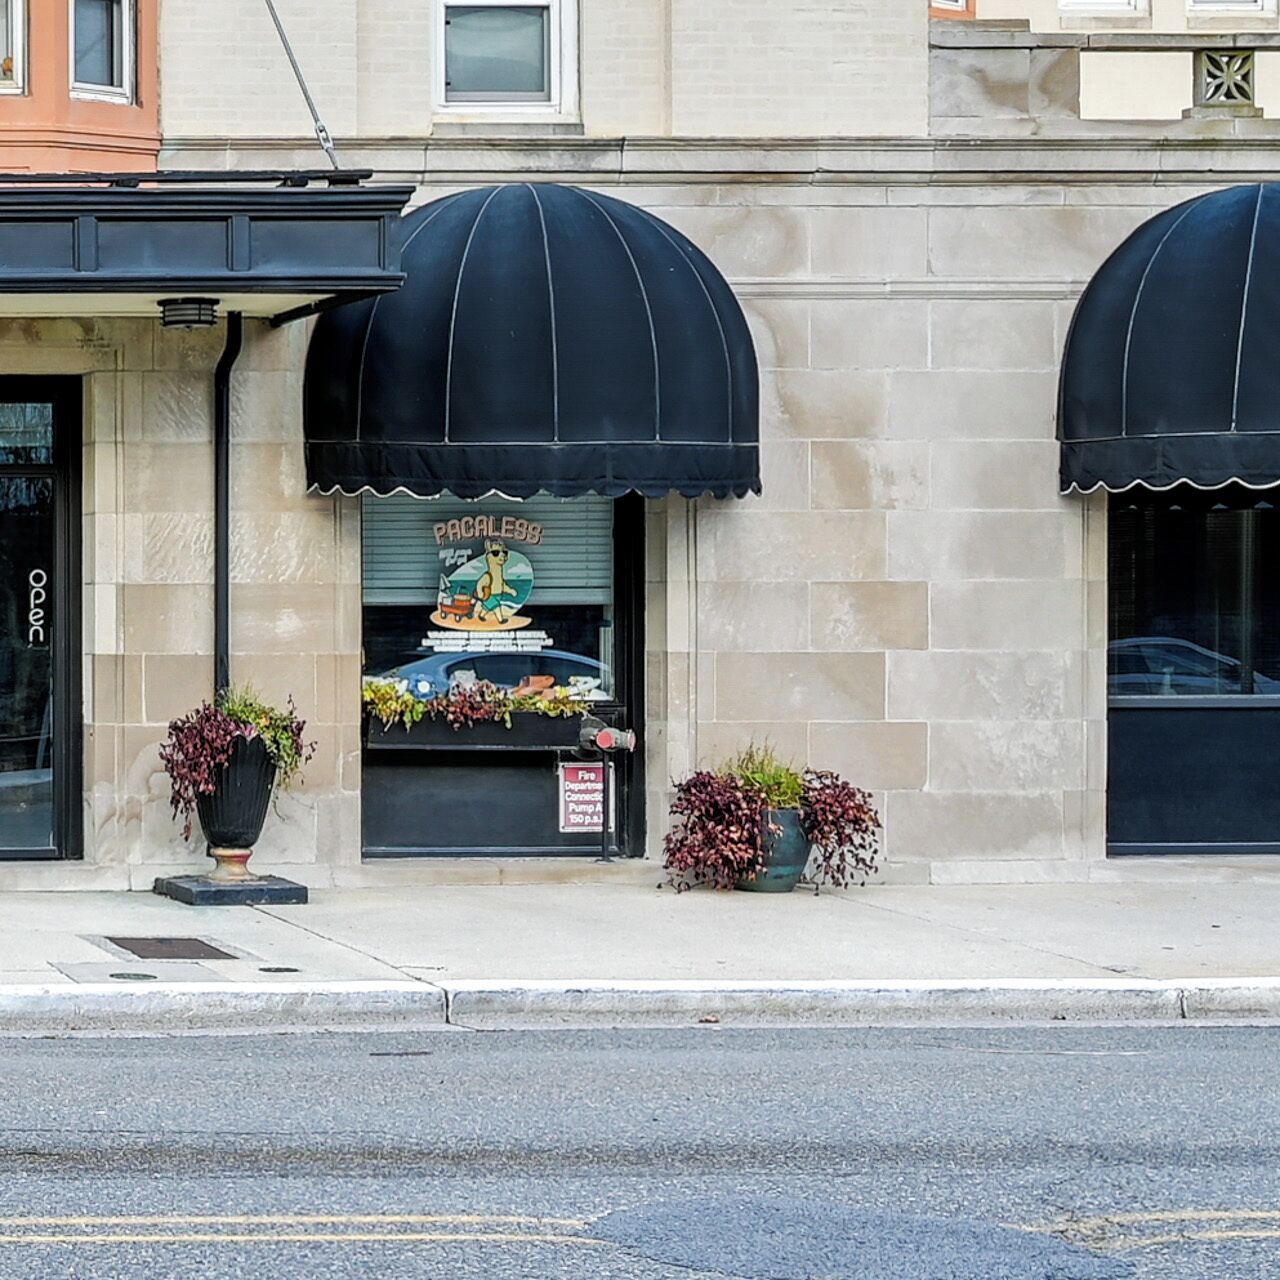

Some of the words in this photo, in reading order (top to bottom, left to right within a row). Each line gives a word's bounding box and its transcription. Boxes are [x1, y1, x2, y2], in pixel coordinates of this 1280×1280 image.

[433, 515, 544, 546] PACALESS
[578, 770, 596, 780] Fire
[569, 802, 594, 813] Pump
[569, 814, 584, 823] 150
